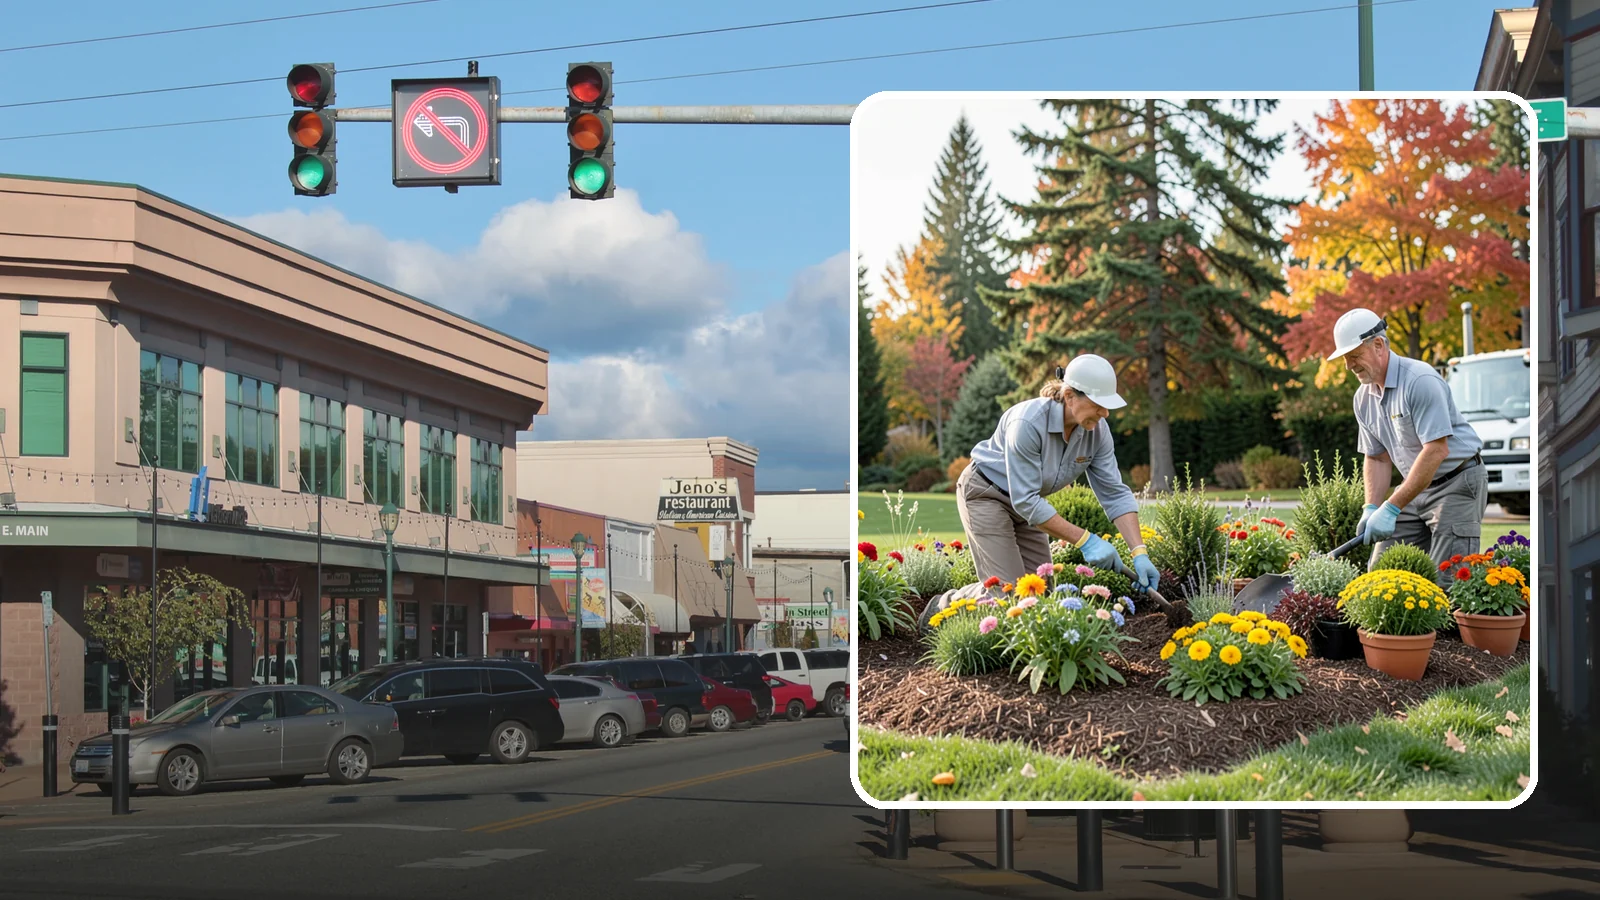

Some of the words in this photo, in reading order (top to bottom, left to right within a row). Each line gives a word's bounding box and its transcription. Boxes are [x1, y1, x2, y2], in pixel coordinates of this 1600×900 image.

[669, 480, 728, 494] Jeno's
[665, 496, 731, 509] restaurant
[658, 509, 682, 520] Italian
[685, 509, 715, 520] American
[714, 509, 737, 520] Cuisine
[2, 525, 13, 536] E.
[15, 525, 49, 536] MAIN
[797, 607, 828, 617] Street
